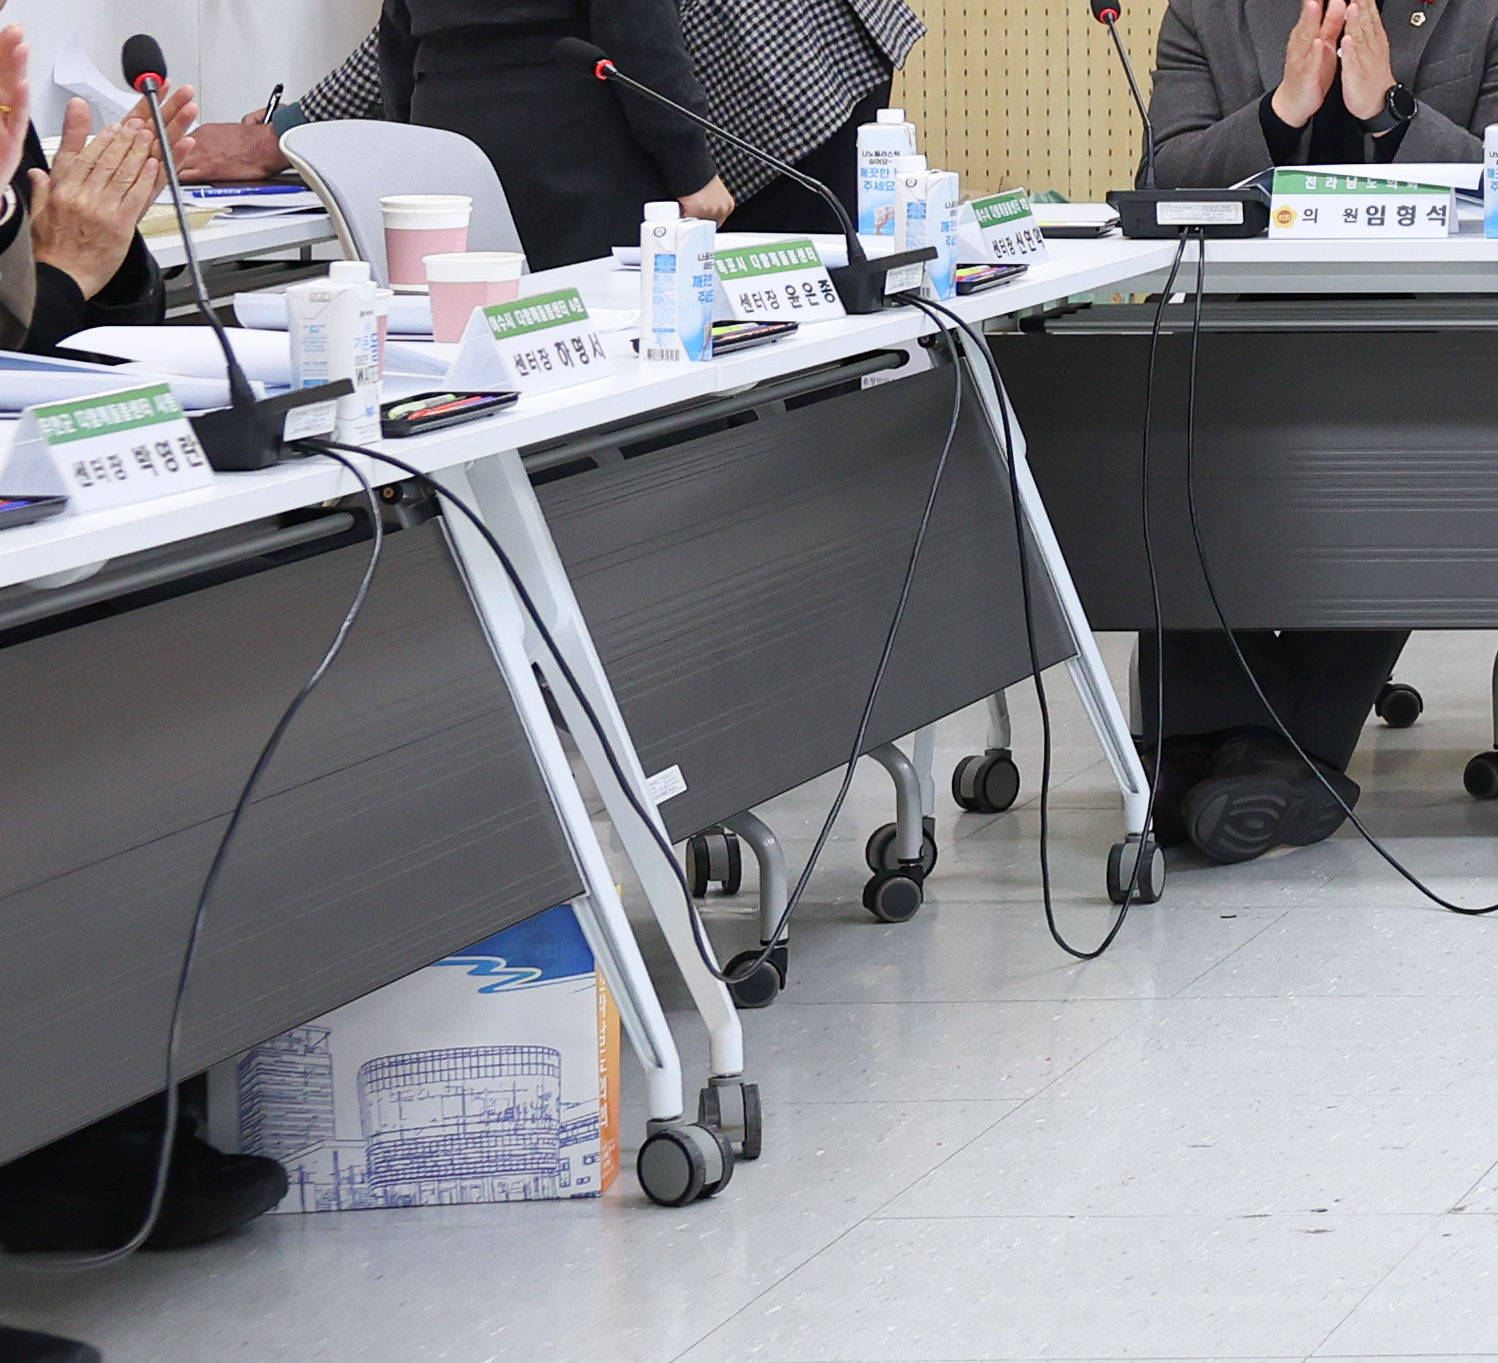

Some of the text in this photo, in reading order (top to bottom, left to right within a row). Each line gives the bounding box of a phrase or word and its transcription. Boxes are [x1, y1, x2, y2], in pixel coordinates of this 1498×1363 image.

[860, 167, 890, 178] 깨끗한
[864, 181, 895, 192] 주세요
[1365, 204, 1448, 227] 임형석
[715, 255, 749, 275] 목포시
[750, 246, 818, 270] 다함께돌봄센터
[739, 279, 836, 314] 센터장 윤은종
[513, 347, 553, 377] 센터장
[71, 453, 128, 488] 센터장
